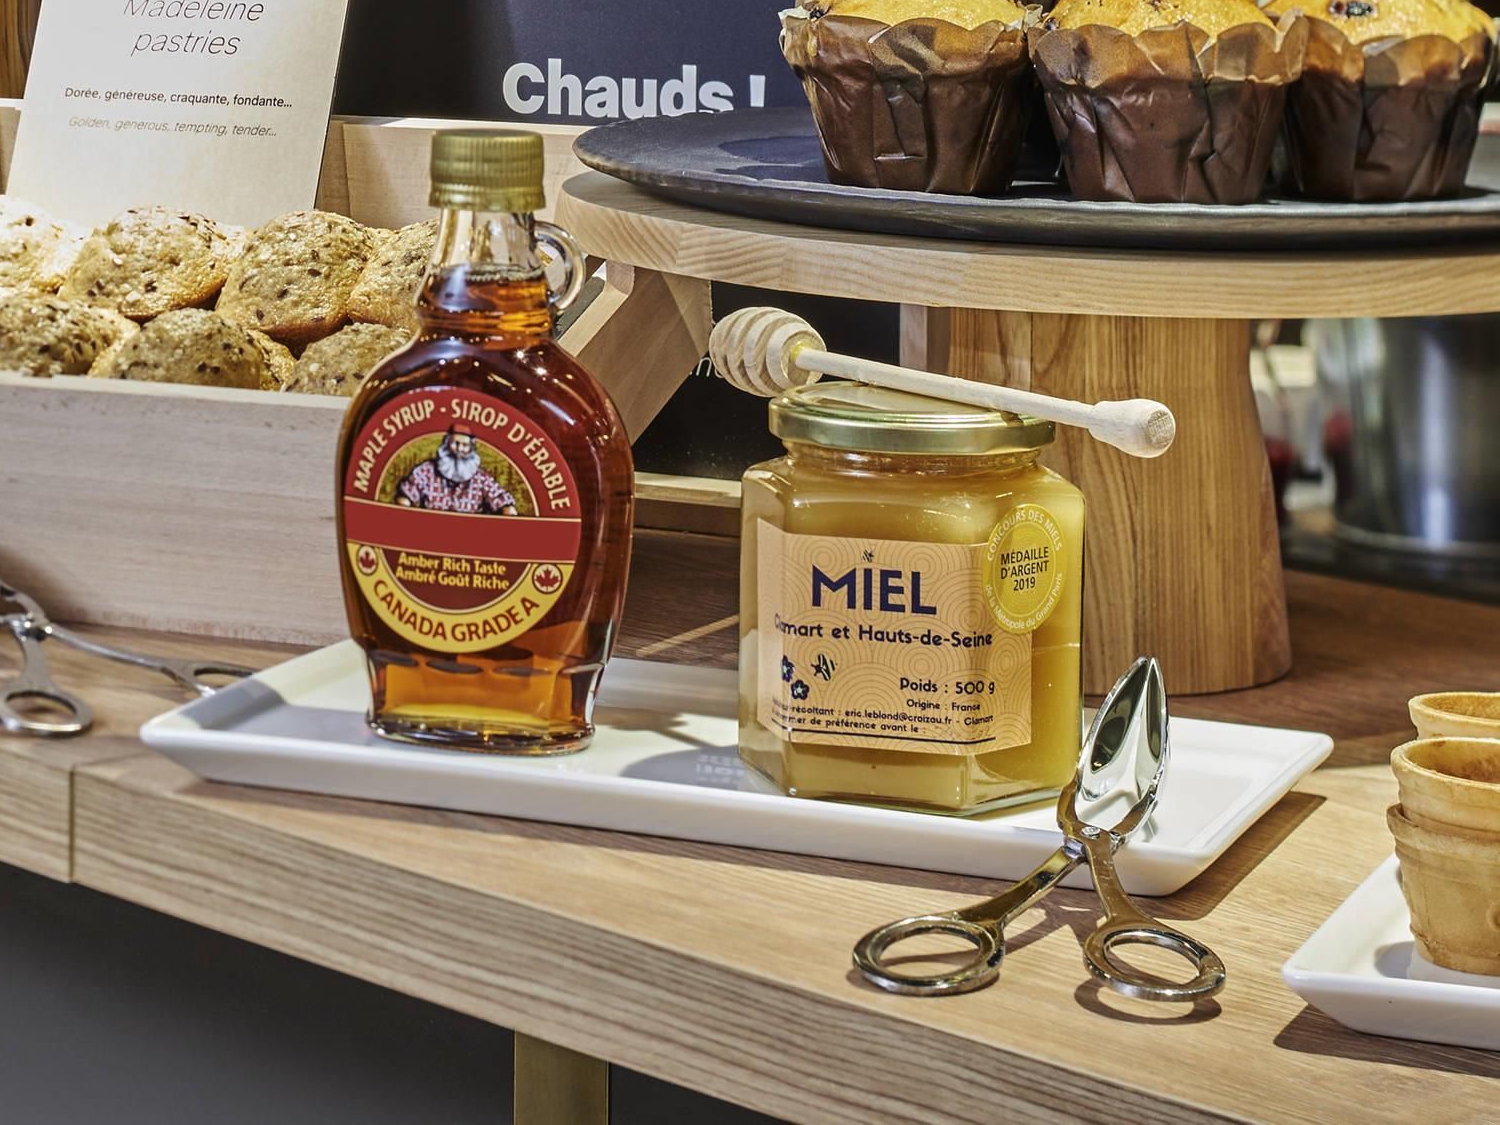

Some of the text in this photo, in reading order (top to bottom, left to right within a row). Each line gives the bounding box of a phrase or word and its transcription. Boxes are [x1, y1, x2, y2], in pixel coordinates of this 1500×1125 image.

[131, 28, 241, 57] pastries
[65, 87, 101, 100] Dorée,
[170, 94, 231, 107] craquante,
[502, 58, 735, 120] Chauds
[174, 120, 228, 137] tempting,
[354, 398, 570, 510] MAPLE SYRUP SIROP D'ÉRABLE
[398, 551, 506, 575] Amber Rich Taste
[1000, 546, 1049, 566] MÉDAILLE
[395, 566, 510, 590] Ambré Goût Riche
[1000, 560, 1050, 580] D'ARGENT
[812, 563, 937, 615] MIEL
[1013, 576, 1036, 592] 2019
[373, 579, 540, 643] CANADA GRADE A
[831, 625, 851, 640] et
[859, 624, 993, 648] Hauts-de-Seine
[900, 677, 939, 694] Poids
[955, 680, 985, 695] 500
[988, 681, 996, 695] g
[906, 698, 941, 712] Origine
[951, 701, 981, 713] France
[809, 715, 822, 726] de
[825, 717, 877, 730] préférence
[880, 721, 907, 733] avant
[910, 723, 919, 733] le
